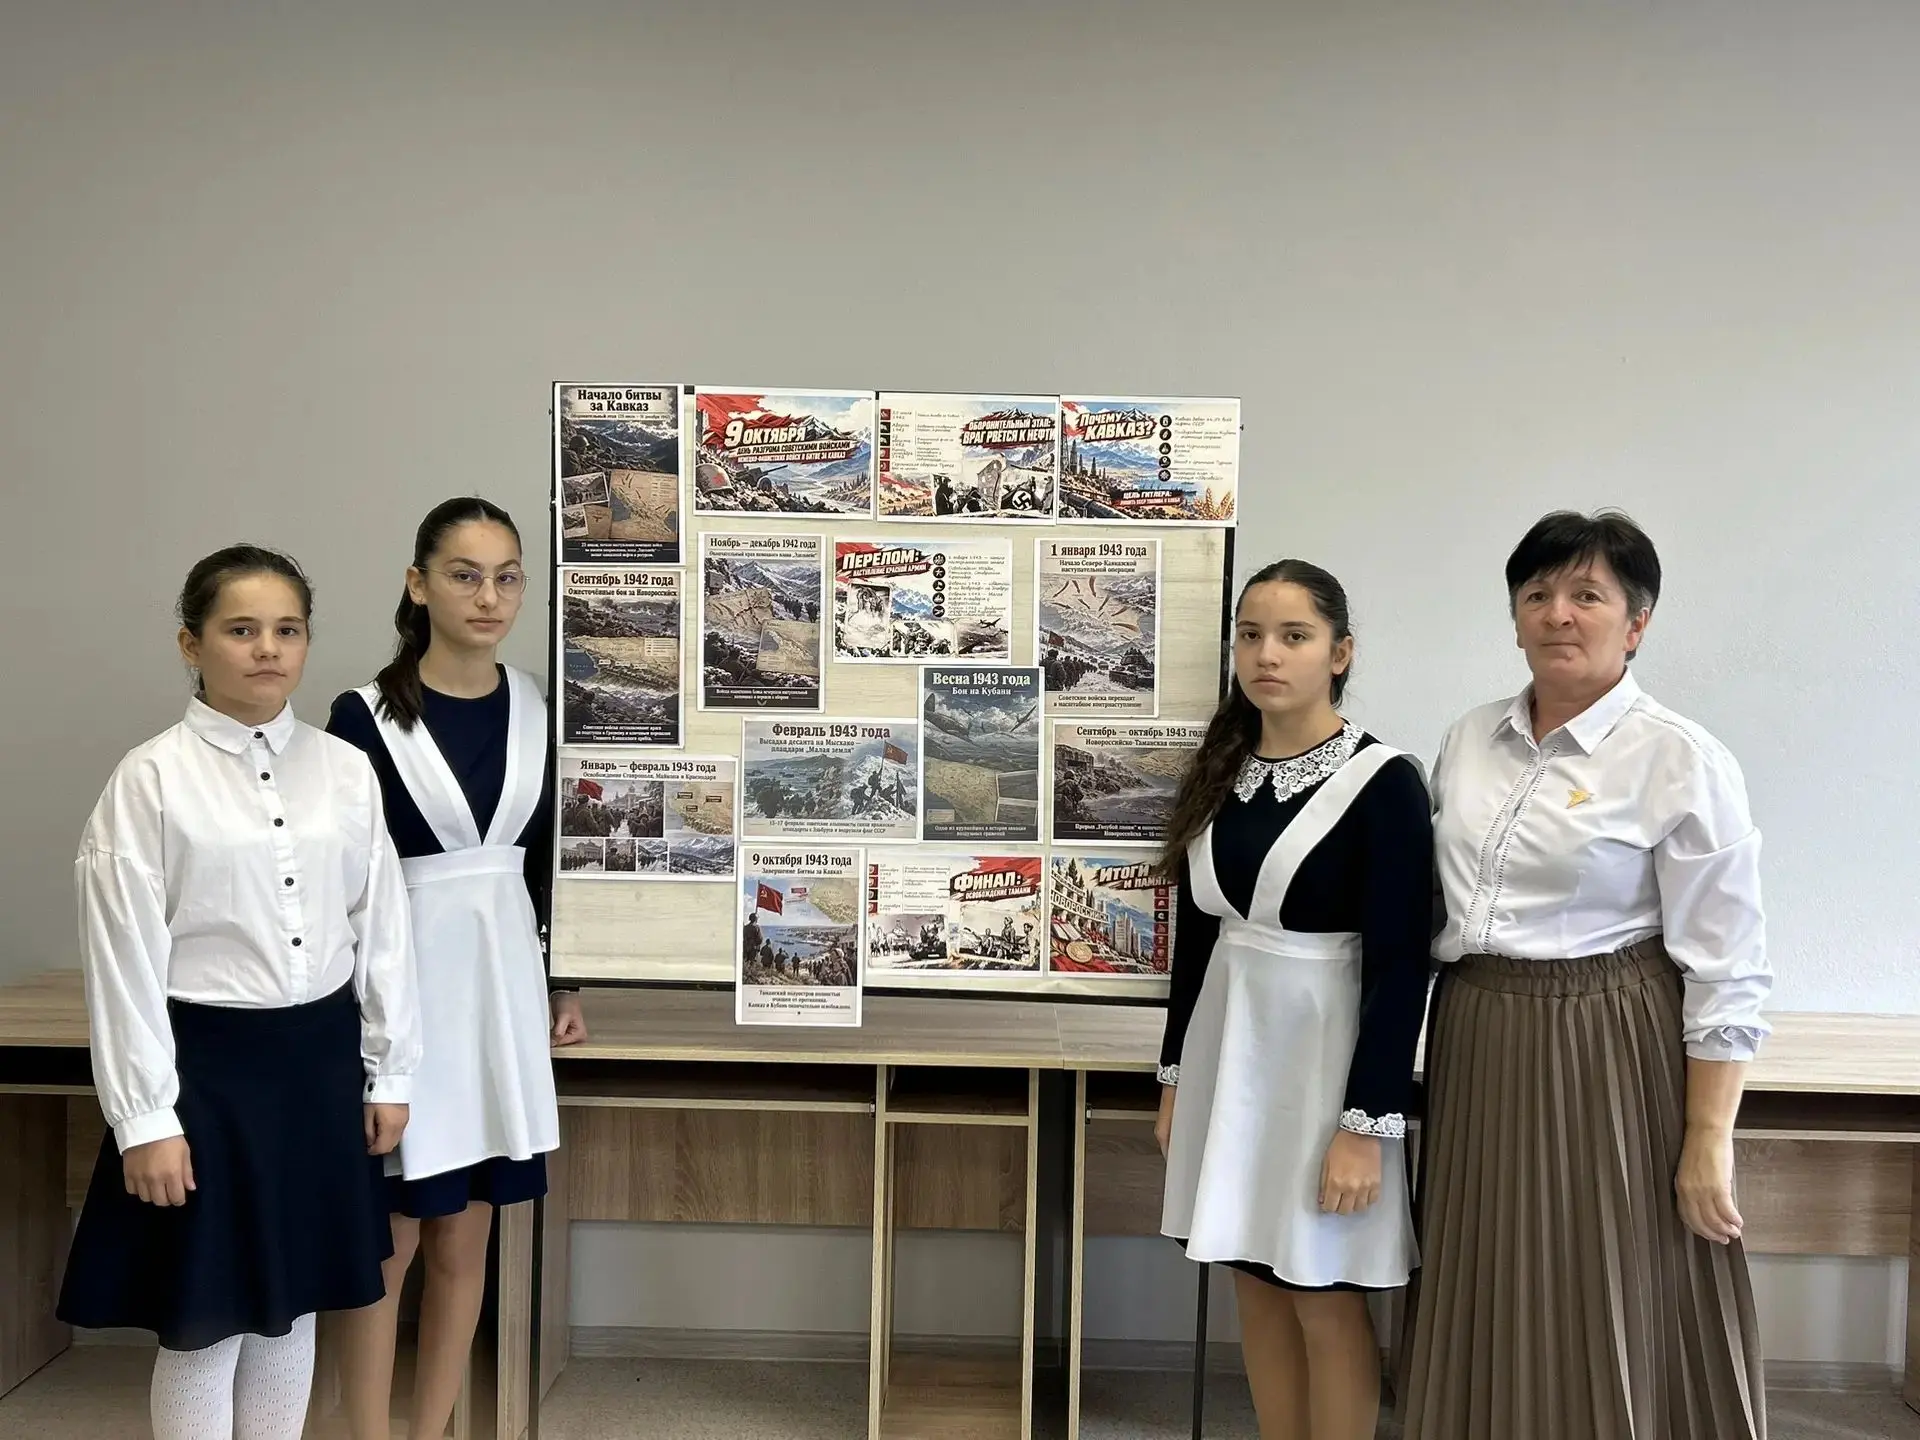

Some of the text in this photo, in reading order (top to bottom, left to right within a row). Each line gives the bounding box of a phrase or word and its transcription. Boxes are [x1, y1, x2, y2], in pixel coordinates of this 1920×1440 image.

[578, 389, 661, 400] Начало битвы
[590, 401, 649, 411] за Кавказ
[969, 419, 1030, 430] ОБОРОНИТЕЛЬНЫЙ
[1032, 418, 1051, 428] ЭТАП:
[1085, 421, 1153, 440] КАВКАЗ?
[724, 421, 806, 447] 9 ОКТЯБРЯ
[963, 431, 984, 444] ВРАГ
[1019, 429, 1026, 442] К
[1027, 428, 1055, 441] НЕФТИ
[737, 440, 851, 455] ДЕНЬ РАЗГРОМА СОВЕТСКИМИ ВОЙСКАМИ
[710, 538, 740, 548] Ноябрь
[750, 539, 780, 550] декабрь
[782, 539, 798, 548] 1942
[800, 541, 816, 549] года
[1051, 544, 1147, 557] 1 января 1943 года
[843, 550, 919, 570] ПЕРЕЛОМ:
[886, 566, 908, 574] КРАСНОЙ
[908, 564, 926, 572] АРМИИ
[571, 573, 674, 586] Сентябрь 1942 года
[616, 588, 627, 596] бои
[636, 589, 677, 597] Новороссийск
[932, 672, 1031, 686] Весна 1943 года
[952, 686, 968, 695] Бои
[981, 688, 1011, 696] Кубани
[772, 723, 891, 738] Февраль 1943 года
[1077, 727, 1116, 737] Сентябрь
[1129, 727, 1163, 737] октябрь
[1166, 728, 1186, 737] 1943
[1189, 730, 1208, 738] года
[1085, 738, 1198, 748] Новороссийско-Таманская операция
[580, 760, 616, 772] Январь
[629, 762, 670, 773] февраль
[672, 762, 694, 772] 1943
[696, 764, 716, 772] года
[753, 854, 852, 867] 9 октября 1943 года
[1100, 864, 1149, 882] ИТОГИ
[954, 871, 1022, 891] ФИНАЛ:
[1124, 880, 1132, 888] И
[965, 887, 1031, 900] ОСВОБОЖДЕНИЕ ТАМАНИ
